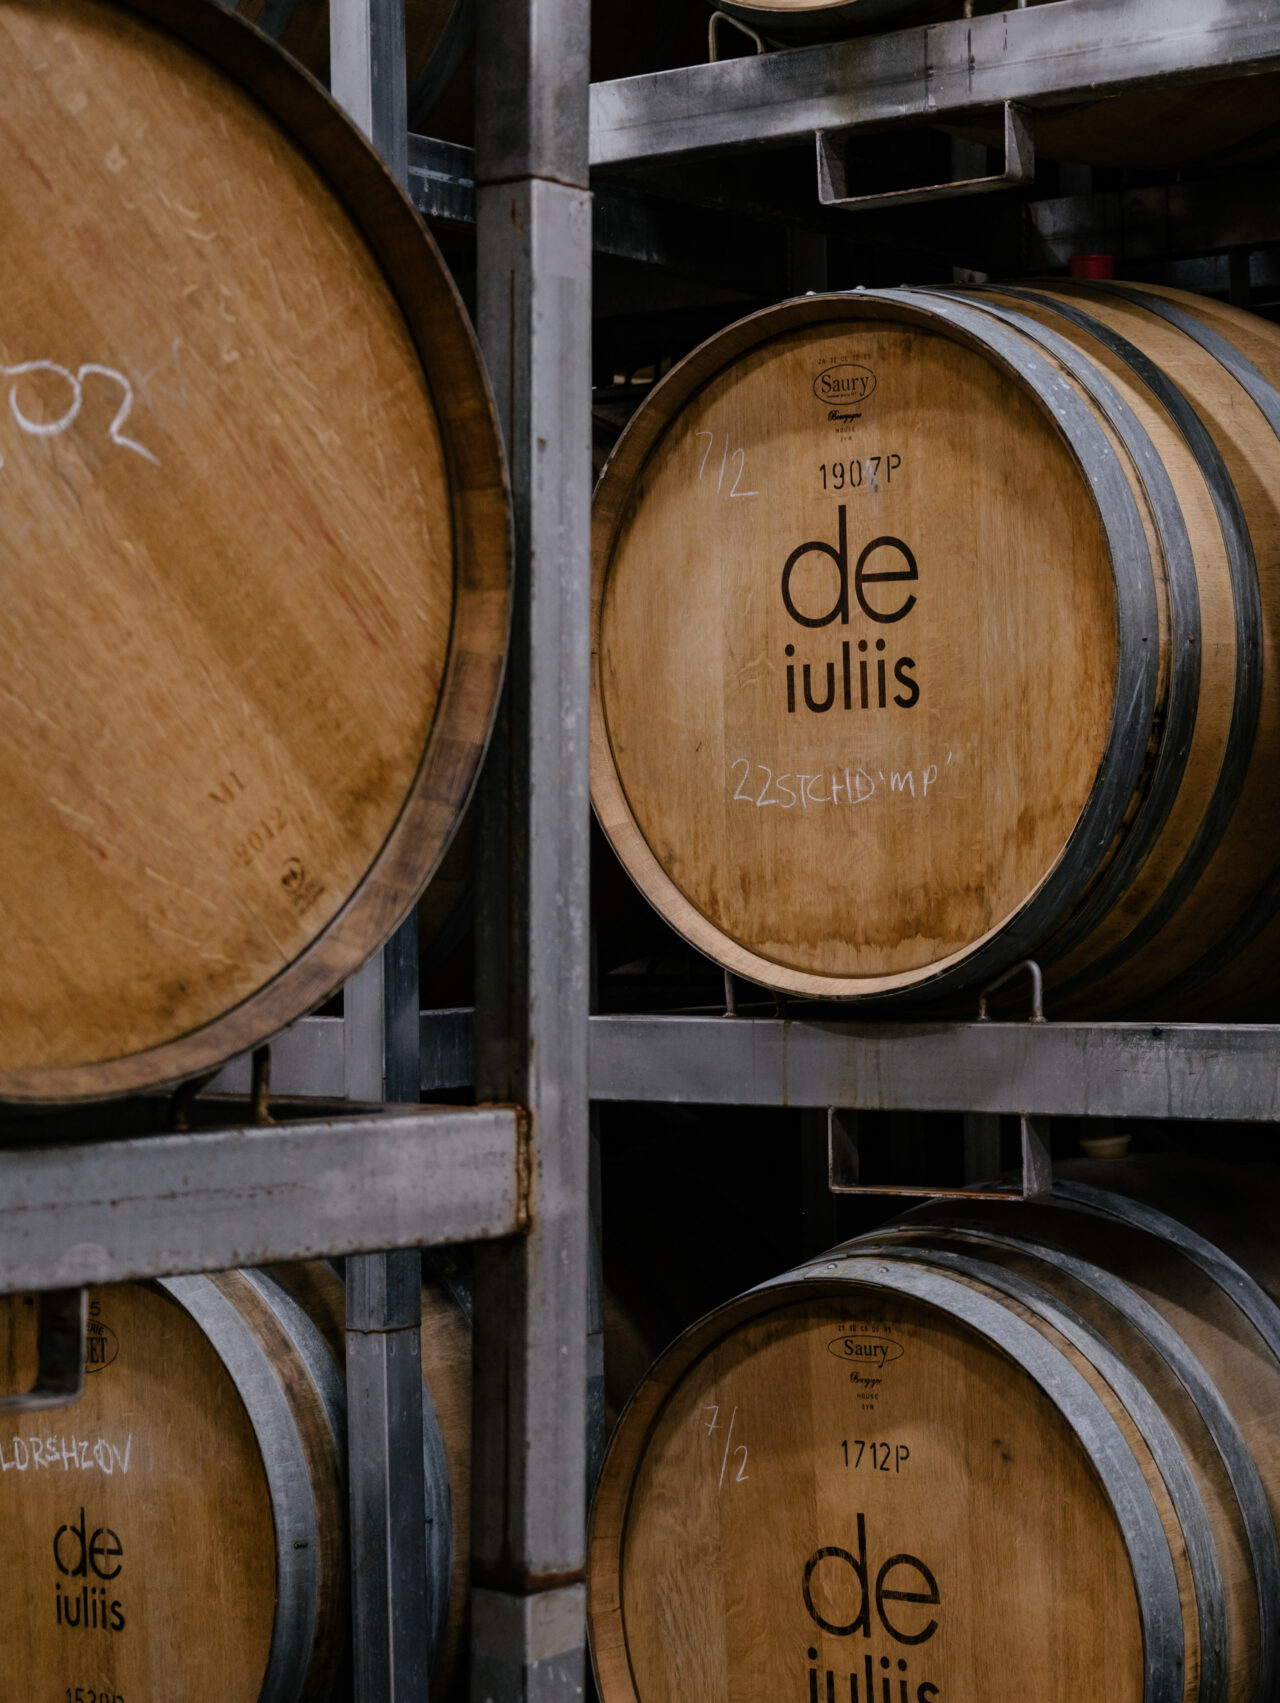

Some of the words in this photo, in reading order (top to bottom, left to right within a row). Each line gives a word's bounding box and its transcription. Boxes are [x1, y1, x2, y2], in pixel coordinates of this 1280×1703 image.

[821, 374, 869, 397] Saury
[819, 454, 902, 490] 1907P
[781, 504, 919, 629] de
[784, 638, 920, 714] iuliis
[843, 1339, 889, 1368] Saury
[841, 1440, 910, 1473] 1712P
[53, 1506, 123, 1580] de
[802, 1512, 941, 1646] de
[55, 1583, 125, 1632] iuliis
